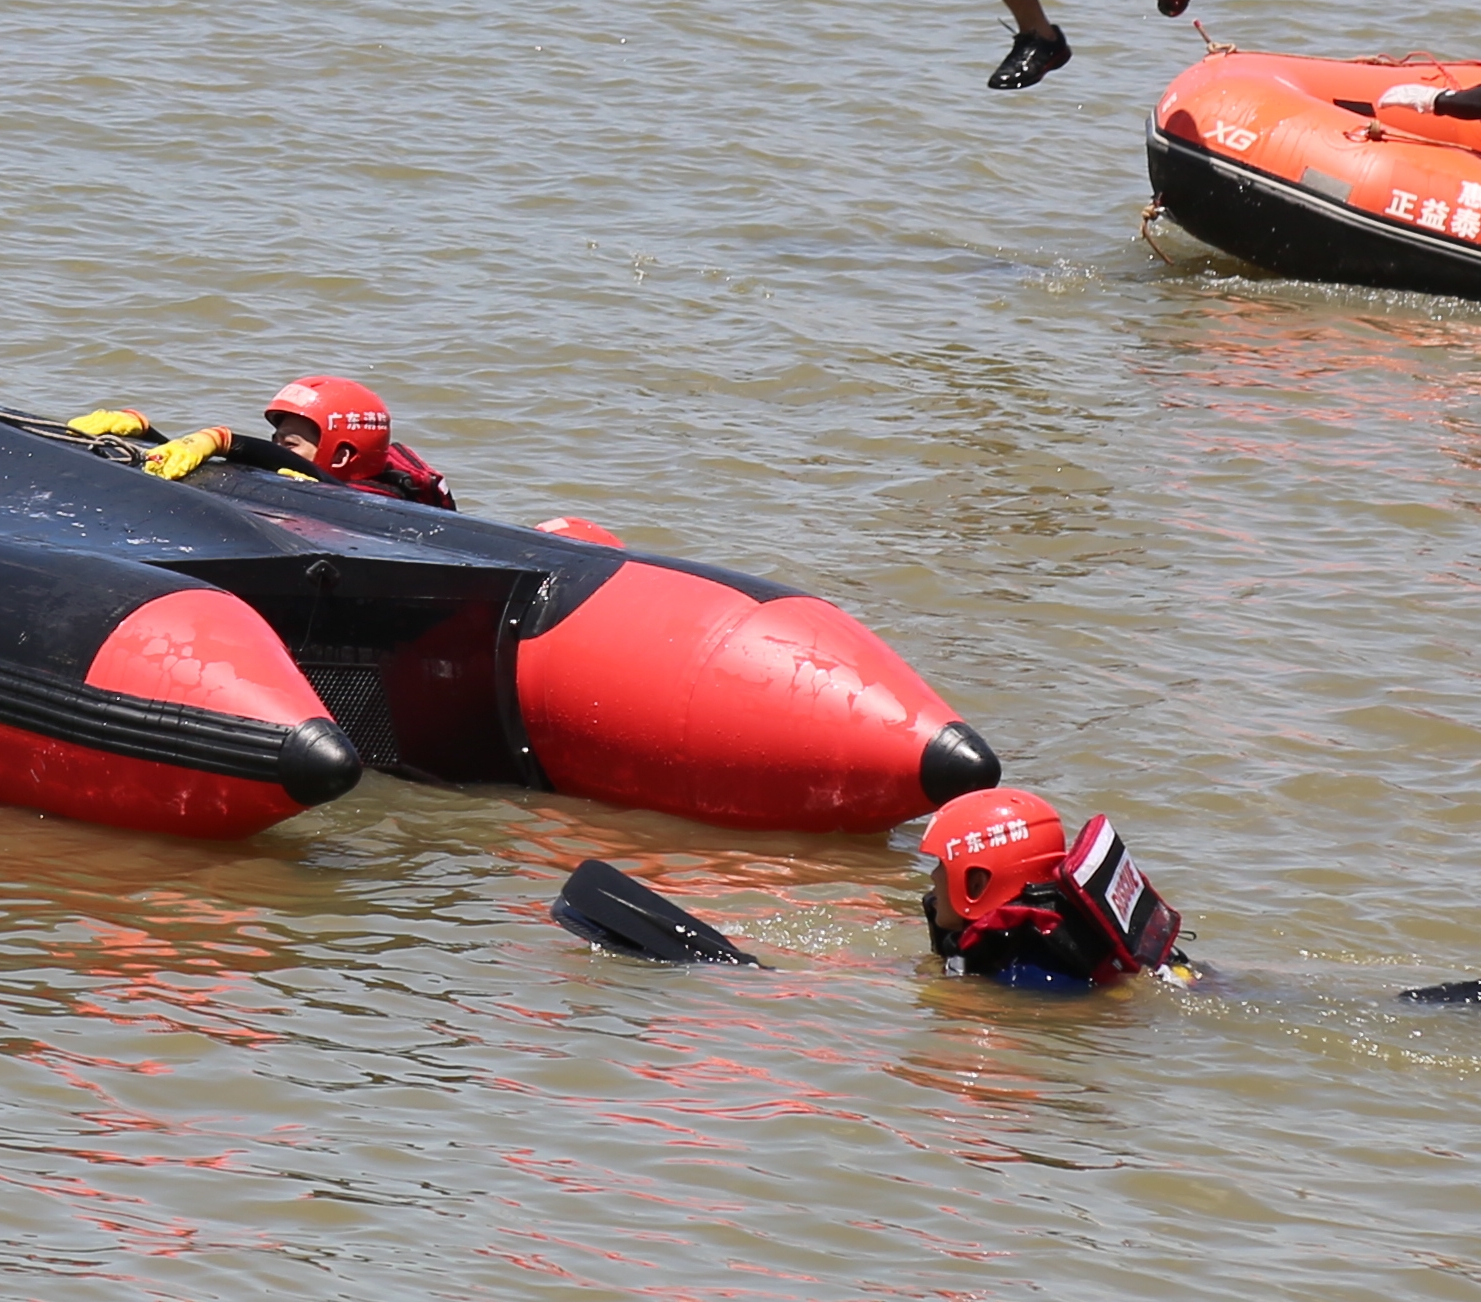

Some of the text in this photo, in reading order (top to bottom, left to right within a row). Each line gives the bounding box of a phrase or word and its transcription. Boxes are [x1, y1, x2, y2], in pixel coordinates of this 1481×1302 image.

[1203, 120, 1258, 152] XG
[328, 411, 388, 431] 广东消防
[945, 819, 1030, 861] 广东消防
